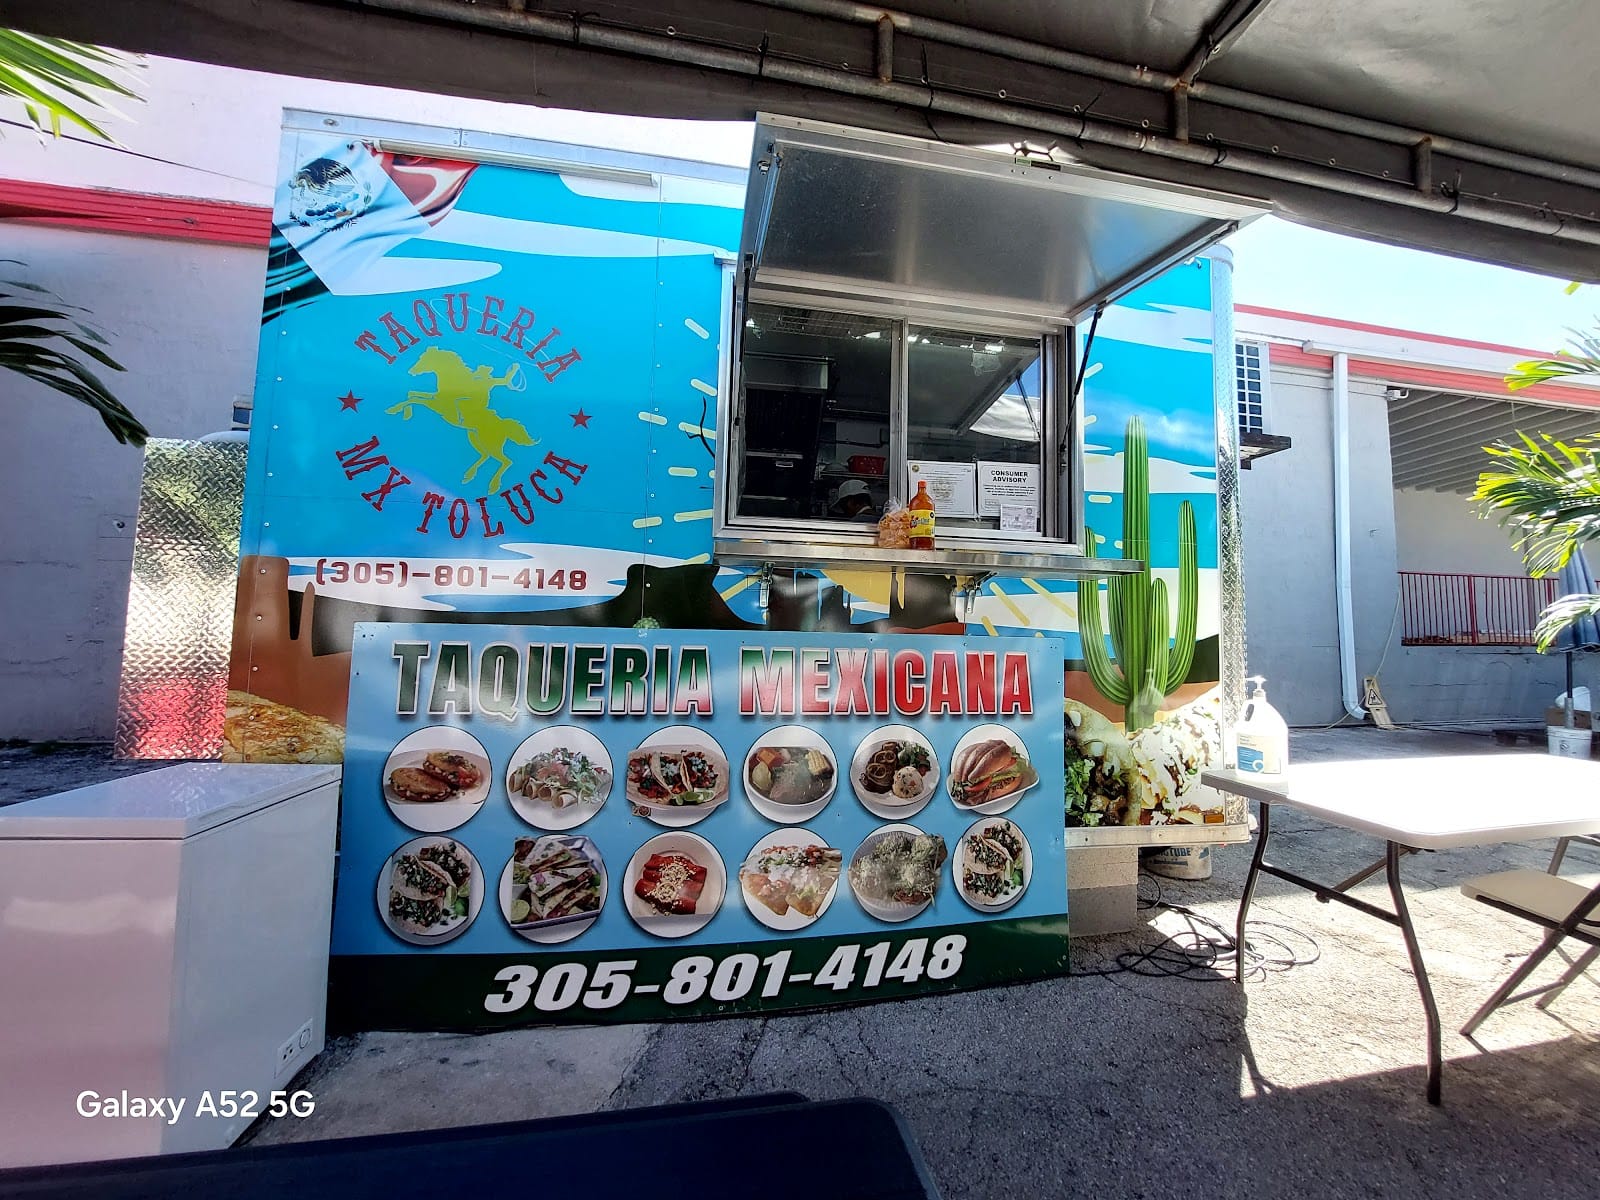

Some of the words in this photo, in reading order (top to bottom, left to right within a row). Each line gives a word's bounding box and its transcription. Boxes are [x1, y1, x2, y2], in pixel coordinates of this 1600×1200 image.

[354, 292, 583, 383] TAQUERIA
[335, 435, 412, 513] MX
[416, 450, 589, 539] TOLUCA
[316, 558, 587, 590] (305)-801-4148
[392, 640, 714, 722] TAQUERIA
[738, 647, 1034, 717] MEXICANA
[483, 933, 968, 1014] 305-801-4148
